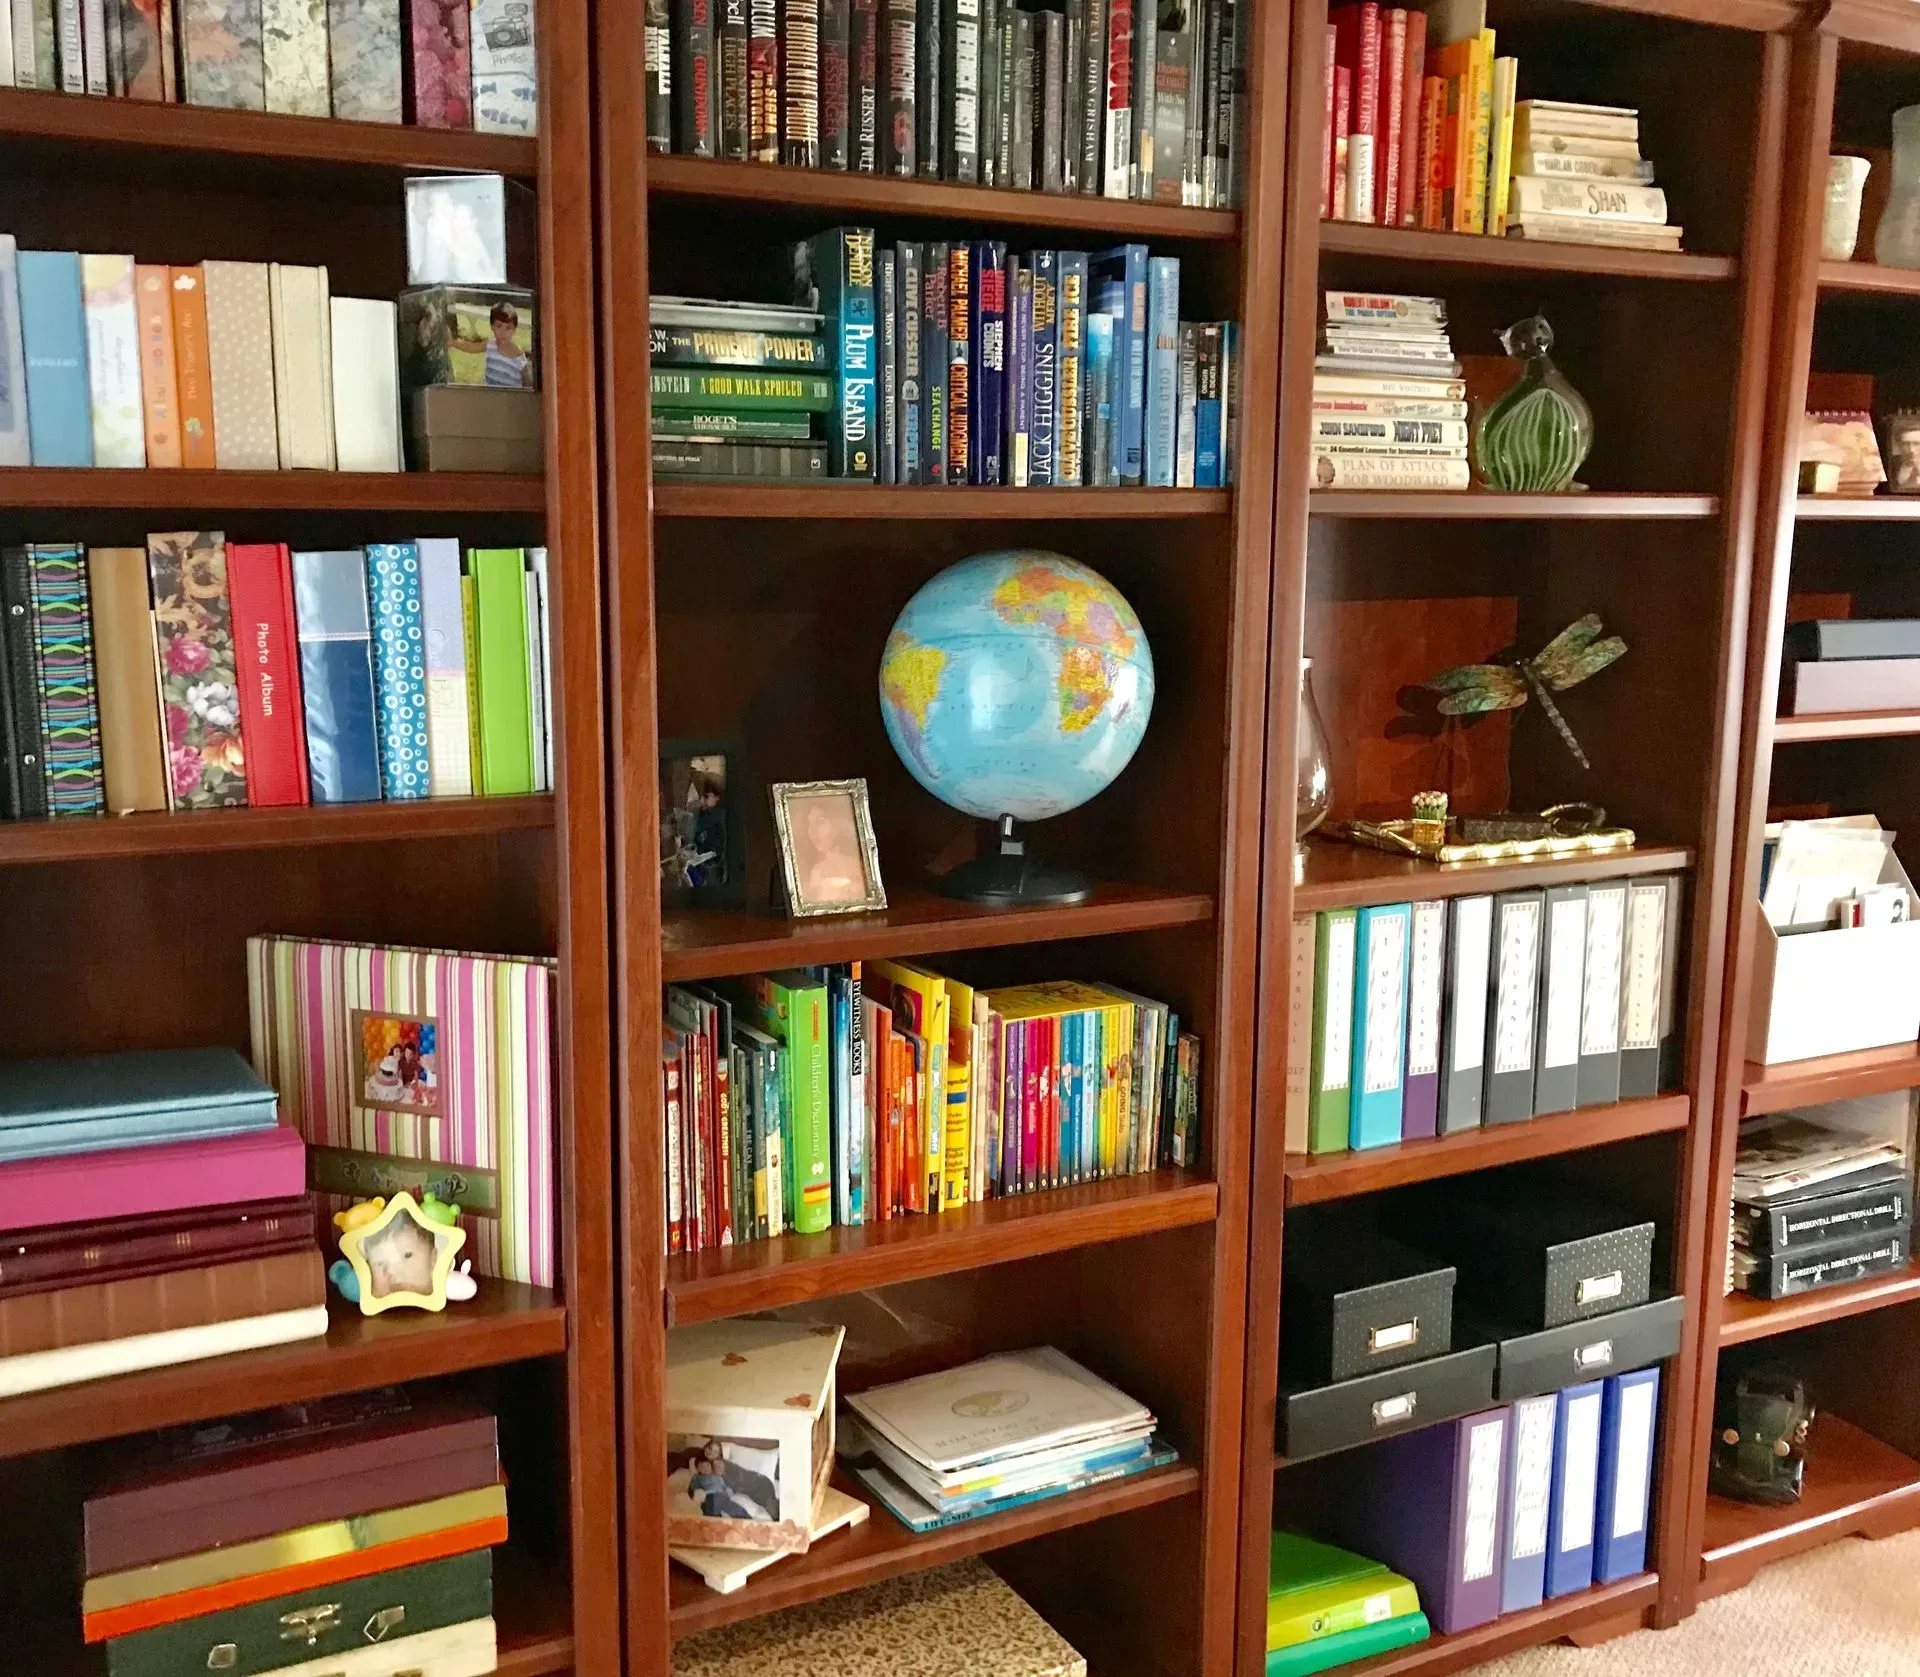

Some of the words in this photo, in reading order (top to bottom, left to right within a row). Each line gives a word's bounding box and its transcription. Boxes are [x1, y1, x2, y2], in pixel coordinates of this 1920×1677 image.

[645, 26, 658, 72] RISING
[724, 36, 737, 73] HIGH
[786, 21, 818, 76] BURDEN
[1361, 8, 1377, 68] PRIMARY
[658, 28, 671, 95] VALHALLA
[738, 38, 747, 110] FRIENDS
[889, 19, 915, 104] CHROMOSOME
[1088, 57, 1099, 95] JOHN
[694, 55, 708, 137] COUNTDOWN
[724, 78, 737, 130] PLACES
[751, 70, 763, 140] PROTOCOL
[764, 87, 777, 134] SIGMA
[786, 79, 818, 98] OF
[825, 43, 838, 139] MESSENGER
[1359, 74, 1374, 132] COLORS
[786, 97, 818, 144] PROOF
[859, 85, 875, 142] RUSSERT
[1085, 98, 1096, 162] GRISHAM
[859, 146, 875, 171] TIM
[1389, 144, 1399, 181] HONG
[1545, 158, 1572, 171] HARLAN
[1387, 186, 1398, 221] KONG
[1587, 184, 1627, 214] SHAN
[861, 235, 873, 288] NELSON
[884, 262, 894, 293] RIGHT
[950, 248, 969, 296] MICHAEL
[905, 267, 919, 308] CLIVE
[924, 273, 937, 320] Parker
[936, 266, 947, 316] Robert
[981, 268, 994, 313] SIEGE
[994, 268, 1005, 313] UNDER
[1032, 275, 1045, 332] WITHOUT
[1045, 283, 1056, 324] MERCY
[1064, 275, 1081, 305] ICE
[884, 312, 894, 346] MONEY
[950, 298, 969, 340] PALMER
[1063, 308, 1080, 349] FIRE
[671, 337, 691, 346] THE
[764, 338, 815, 362] POWER
[845, 323, 875, 370] PLUM
[905, 311, 919, 377] CUSSLER
[983, 322, 994, 368] COONTS
[994, 320, 1004, 371] STEPHEN
[700, 377, 707, 394] A
[709, 377, 732, 395] GOOD
[735, 378, 761, 396] WALK
[764, 379, 802, 397] SPOILED
[884, 364, 894, 392] LOUIS
[931, 386, 941, 405] SEA
[950, 365, 969, 408] CRITICAL
[1033, 343, 1054, 426] HIGGINS
[1060, 356, 1080, 429] CUSSLER
[1159, 368, 1171, 401] COLD
[693, 415, 737, 424] ROGET'S
[845, 377, 875, 442] ISLAND
[884, 395, 894, 445] RUKEYSER
[931, 407, 941, 450] CHANGE
[1018, 400, 1026, 430] PARENT
[905, 403, 919, 469] SERPENT
[950, 411, 968, 468] JUDGMENT
[1059, 430, 1079, 480] CLIVE
[1158, 408, 1170, 461] SERVICE
[1330, 445, 1337, 453] 24
[1338, 445, 1364, 454] Essential
[1365, 446, 1388, 454] Lessons
[1398, 447, 1428, 455] Investment
[1429, 448, 1452, 456] Success
[1030, 431, 1053, 484] JACK
[1342, 459, 1375, 471] PLAN
[1380, 459, 1394, 471] OF
[1402, 461, 1449, 473] ATTACK
[1342, 474, 1369, 486] BOB
[1372, 475, 1449, 488] WOODWARD
[255, 622, 269, 665] Photo
[258, 672, 273, 717] Album
[852, 981, 862, 1038] EYEWITNESS
[810, 1044, 821, 1096] Children's
[851, 1039, 861, 1075] BOOKS
[720, 1093, 729, 1115] GOD'S
[1027, 1101, 1036, 1134] Matilda
[1118, 1086, 1127, 1113] GOING
[1187, 1077, 1197, 1113] Survival
[720, 1116, 730, 1156] GREATNESS
[810, 1101, 823, 1158] Dictionary
[930, 1131, 940, 1153] WHY
[1788, 1216, 1831, 1232] HORIZONTAL
[1831, 1208, 1874, 1223] DIRECTIONAL
[1874, 1204, 1893, 1215] DRILL
[1788, 1263, 1830, 1279] HORIZONTAL
[1830, 1252, 1872, 1269] DIRECTIONAL
[1872, 1248, 1891, 1258] DRILL
